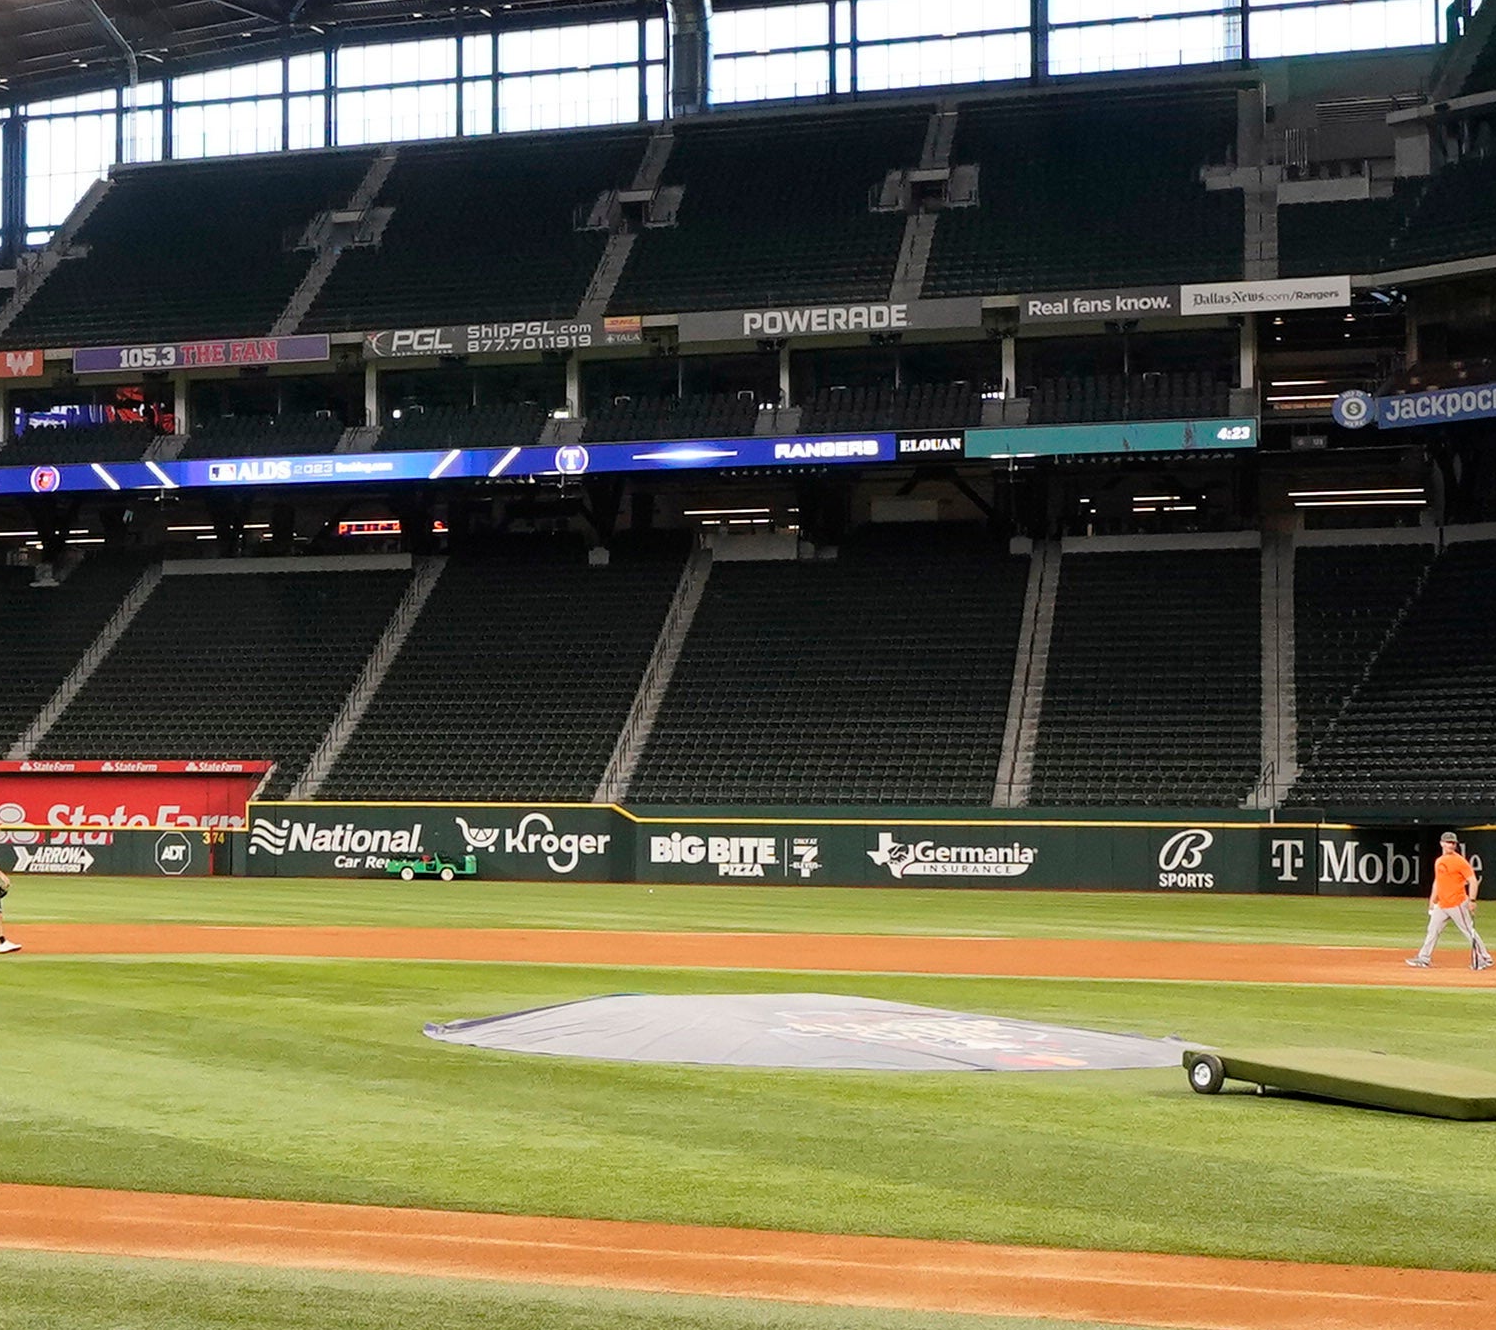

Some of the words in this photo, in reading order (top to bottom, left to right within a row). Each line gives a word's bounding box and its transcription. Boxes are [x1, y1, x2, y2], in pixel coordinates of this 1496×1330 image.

[1028, 299, 1069, 317] Real
[1073, 296, 1111, 314] fans
[1116, 294, 1172, 312] know.
[744, 304, 908, 336] POWERADE
[391, 329, 453, 351] PGL
[467, 321, 592, 340] ShipPGL.com
[467, 335, 592, 353] 877.701.1919
[119, 347, 176, 368] 105.3
[180, 343, 225, 364] THE
[229, 340, 278, 362] FAN
[1217, 426, 1250, 440] 4:23
[774, 440, 879, 459] RANGERS
[900, 437, 961, 453] ELOUAN
[237, 461, 291, 481] ALDS
[293, 463, 333, 475] 2023
[288, 823, 423, 853] National
[505, 813, 610, 873] Kroger
[33, 846, 82, 863] ARROW
[161, 847, 185, 861] ADT
[708, 837, 777, 864] BITE
[913, 840, 1033, 865] Germania
[334, 855, 360, 869] Car
[719, 863, 765, 878] PIZZA
[923, 864, 1012, 875] INSURANCE
[1271, 840, 1304, 881] T
[1319, 840, 1482, 884] Mobie
[1159, 872, 1214, 889] SPORTS
